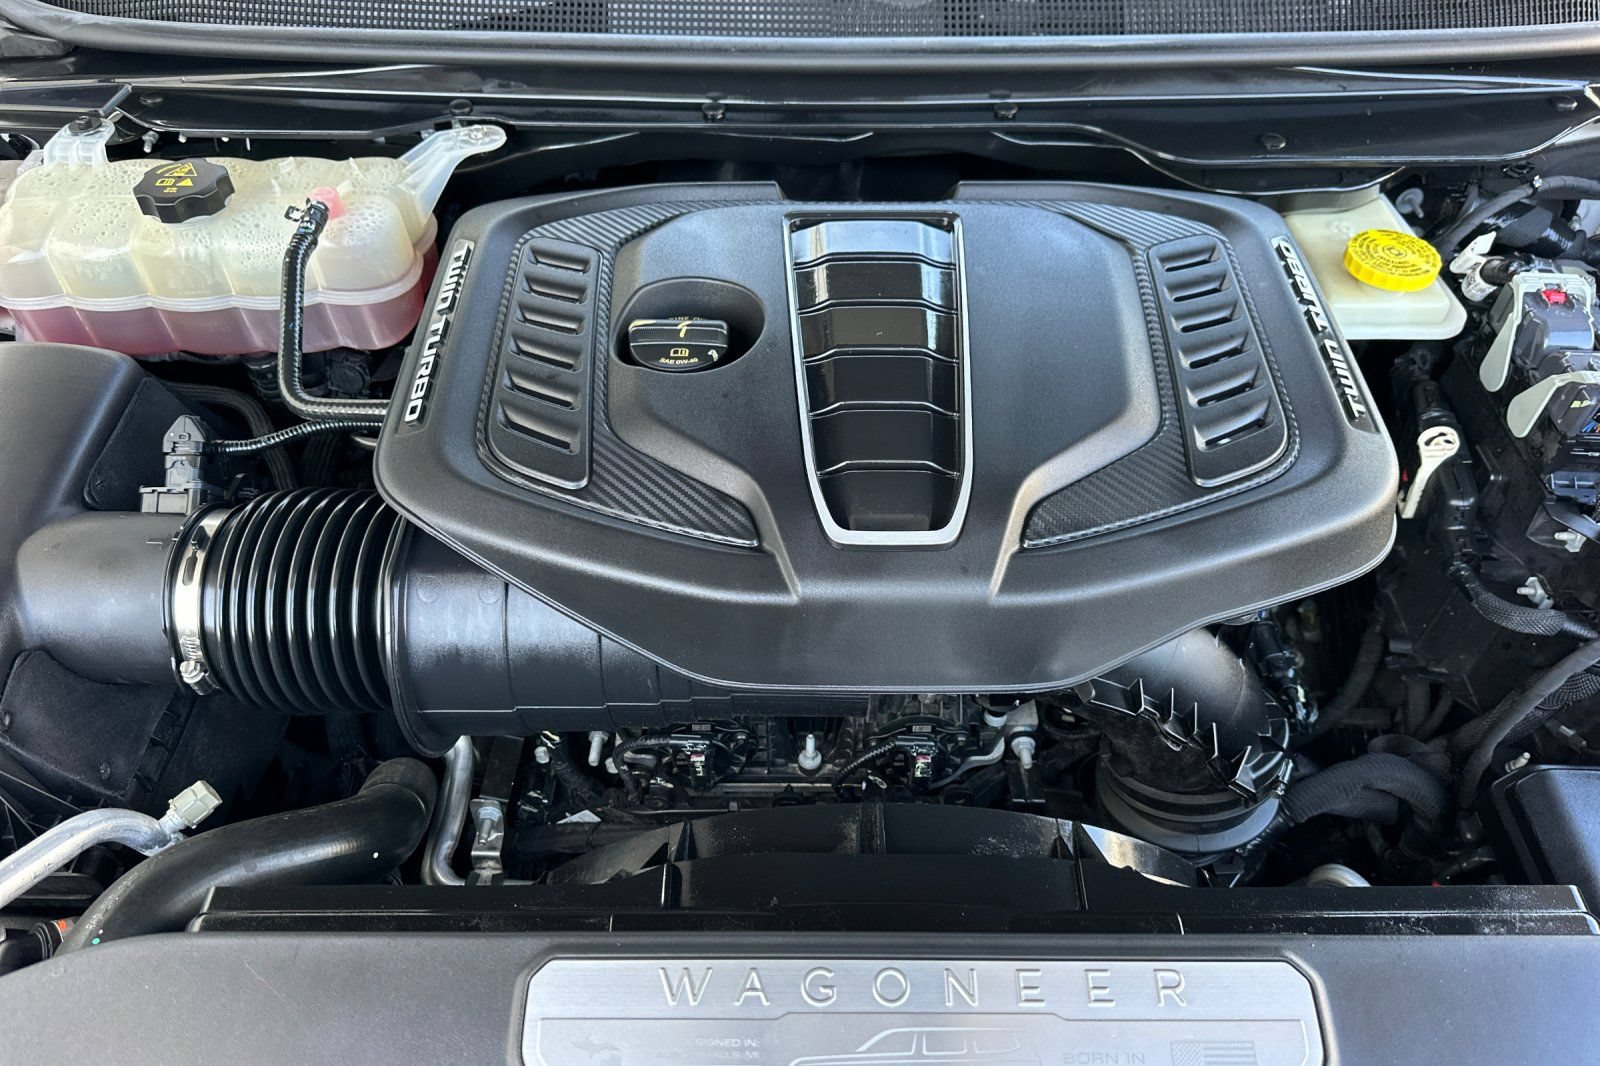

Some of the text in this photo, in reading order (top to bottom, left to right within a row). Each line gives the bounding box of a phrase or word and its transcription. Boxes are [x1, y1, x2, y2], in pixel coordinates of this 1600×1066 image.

[405, 243, 471, 425] TWIN TURBO
[1276, 240, 1366, 420] TWIN TURBO
[658, 966, 1187, 1007] WAGONEER
[1062, 1051, 1145, 1065] BORN IN
